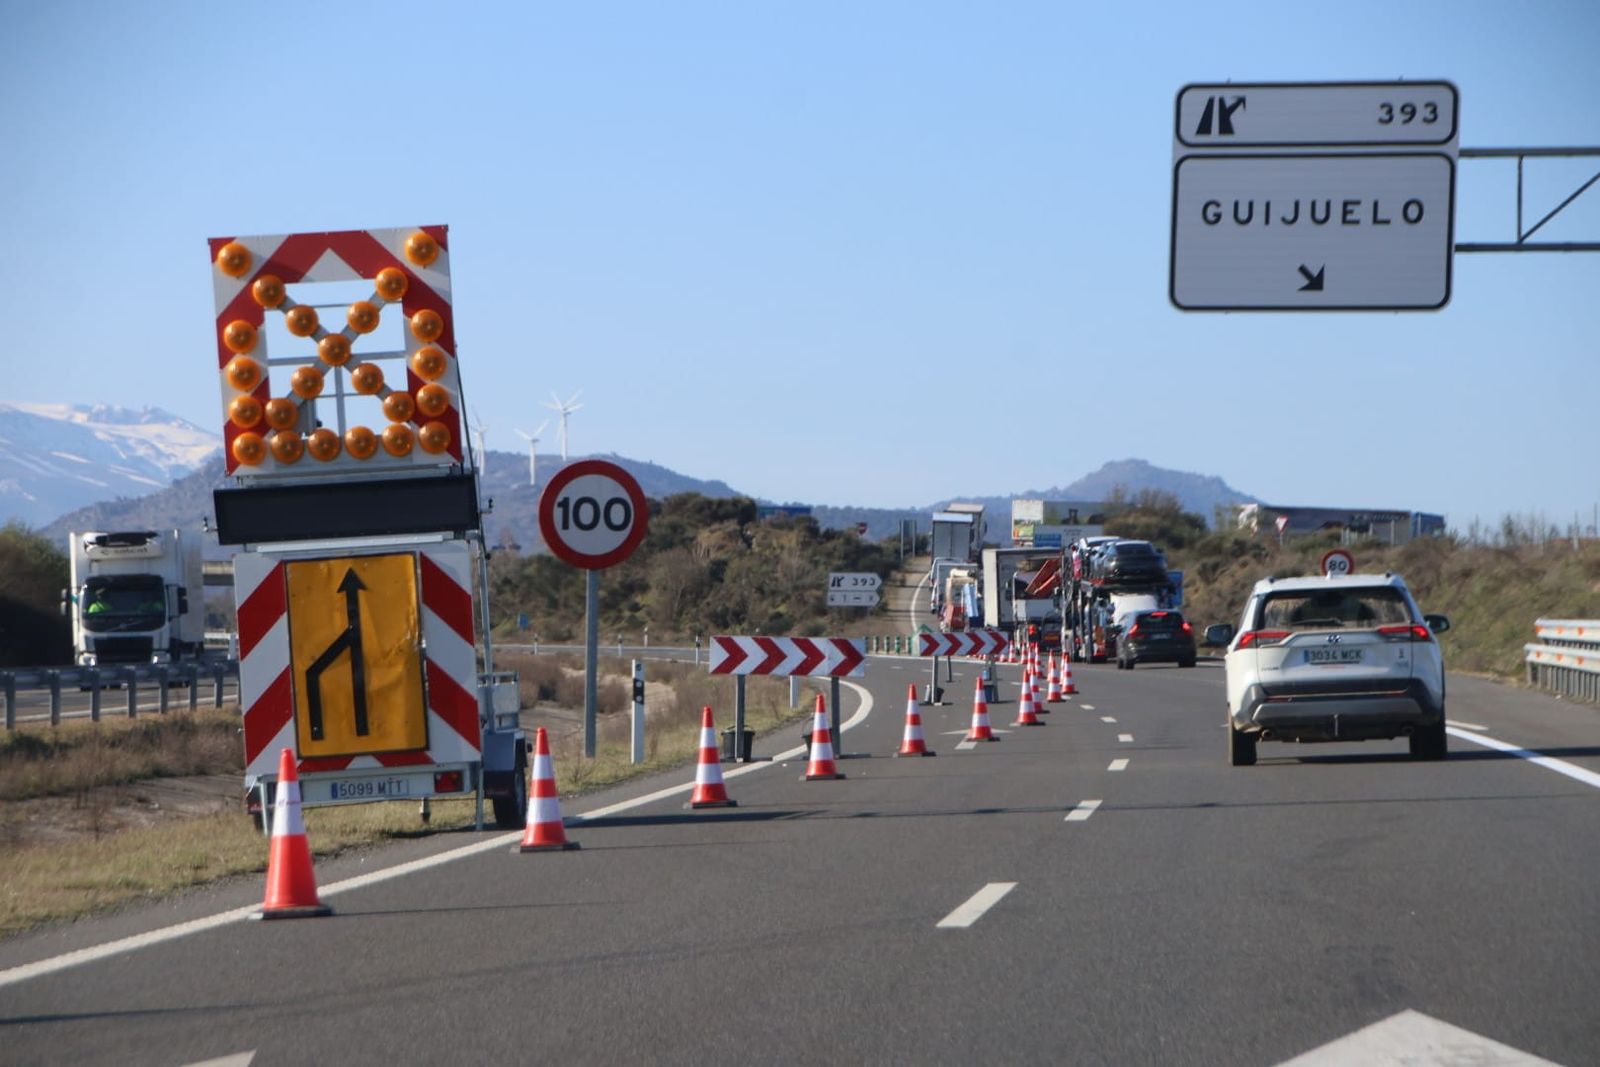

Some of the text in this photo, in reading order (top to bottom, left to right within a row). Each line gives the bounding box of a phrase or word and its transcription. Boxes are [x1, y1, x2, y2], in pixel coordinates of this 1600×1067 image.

[1377, 102, 1438, 124] 393
[1202, 199, 1424, 225] GUIJUELO
[557, 497, 631, 531] 100
[1329, 560, 1347, 572] 80
[852, 577, 875, 586] 393
[340, 779, 402, 796] 5099 MTT
